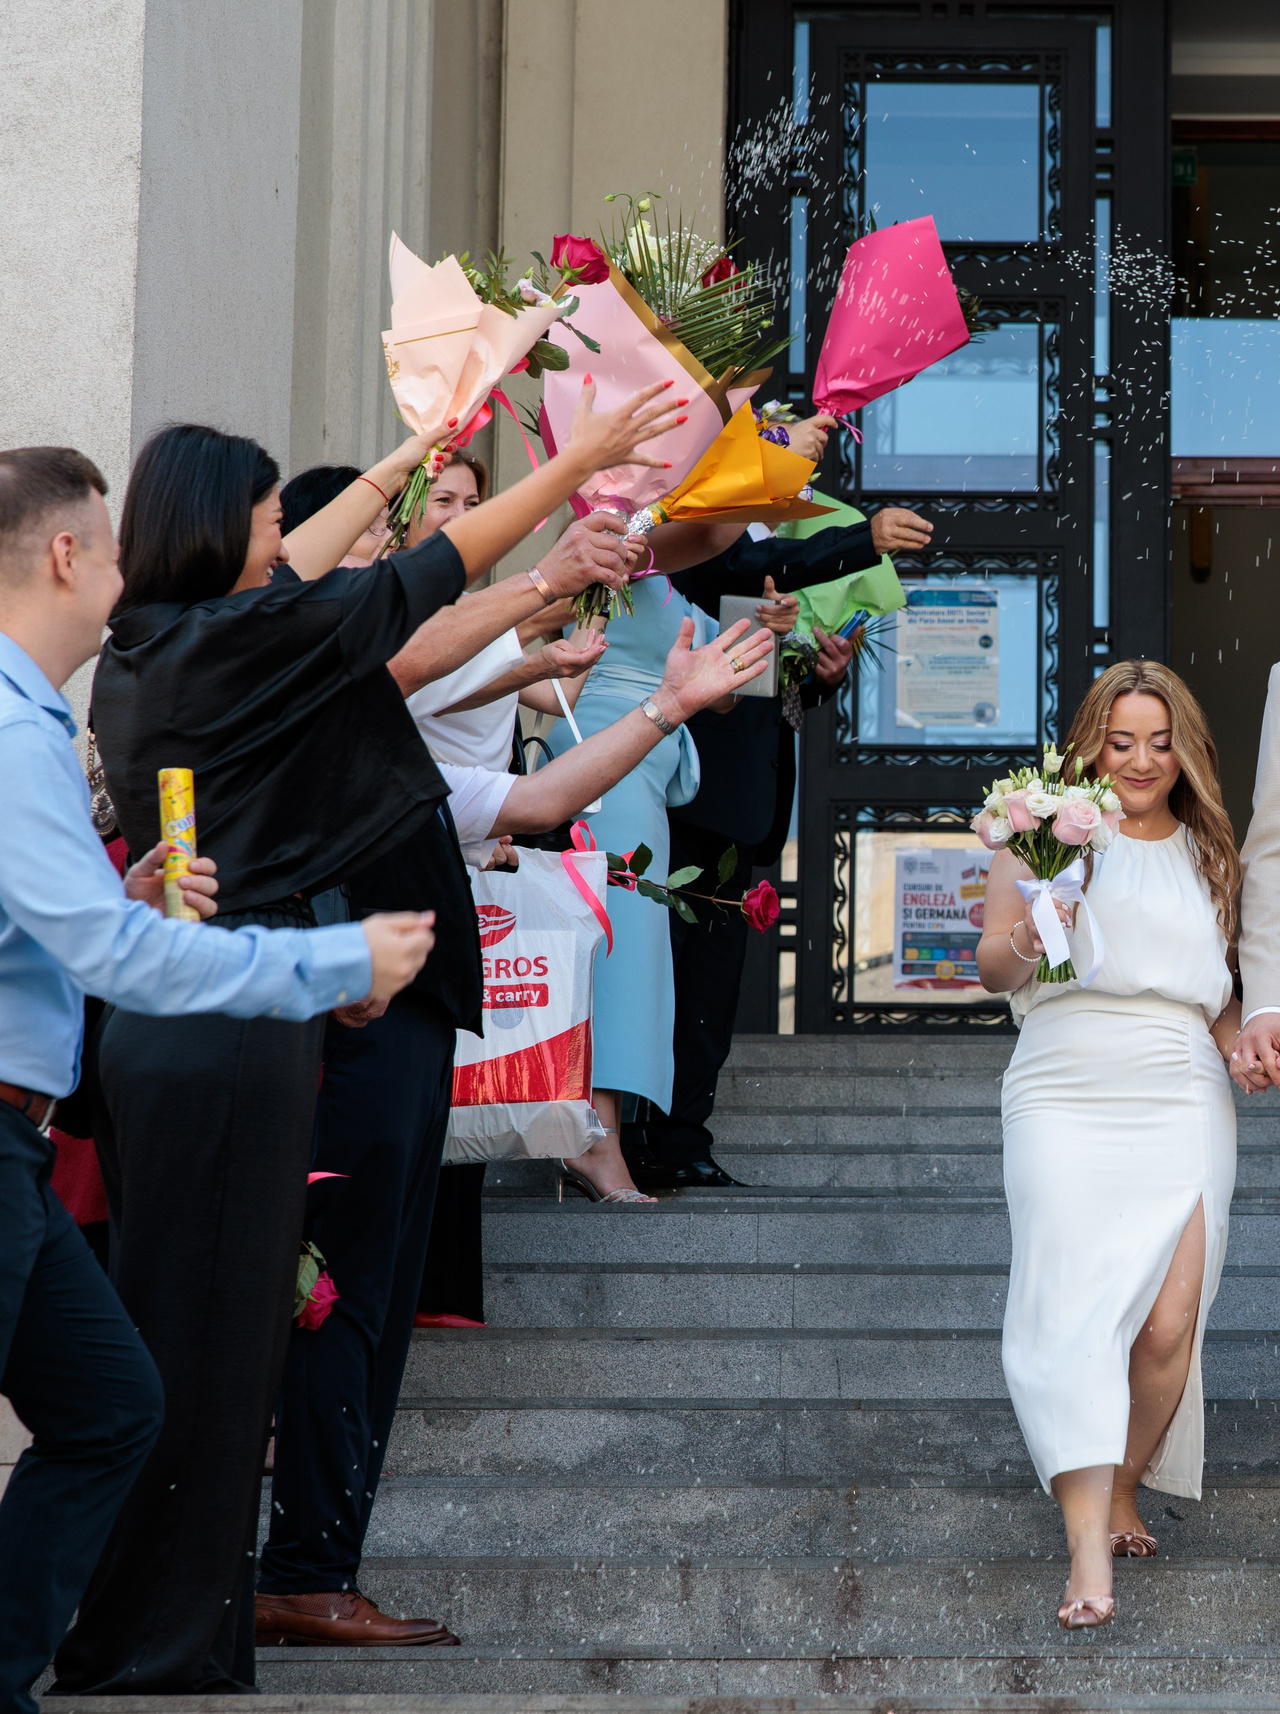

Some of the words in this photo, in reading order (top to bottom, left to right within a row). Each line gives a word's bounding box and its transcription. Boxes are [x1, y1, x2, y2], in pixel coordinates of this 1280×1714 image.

[903, 883, 933, 891] CURSURI
[935, 883, 943, 891] DE
[902, 891, 956, 907] ENGLEZĂ
[915, 906, 968, 920] GERMANĂ
[495, 990, 541, 1004] carry
